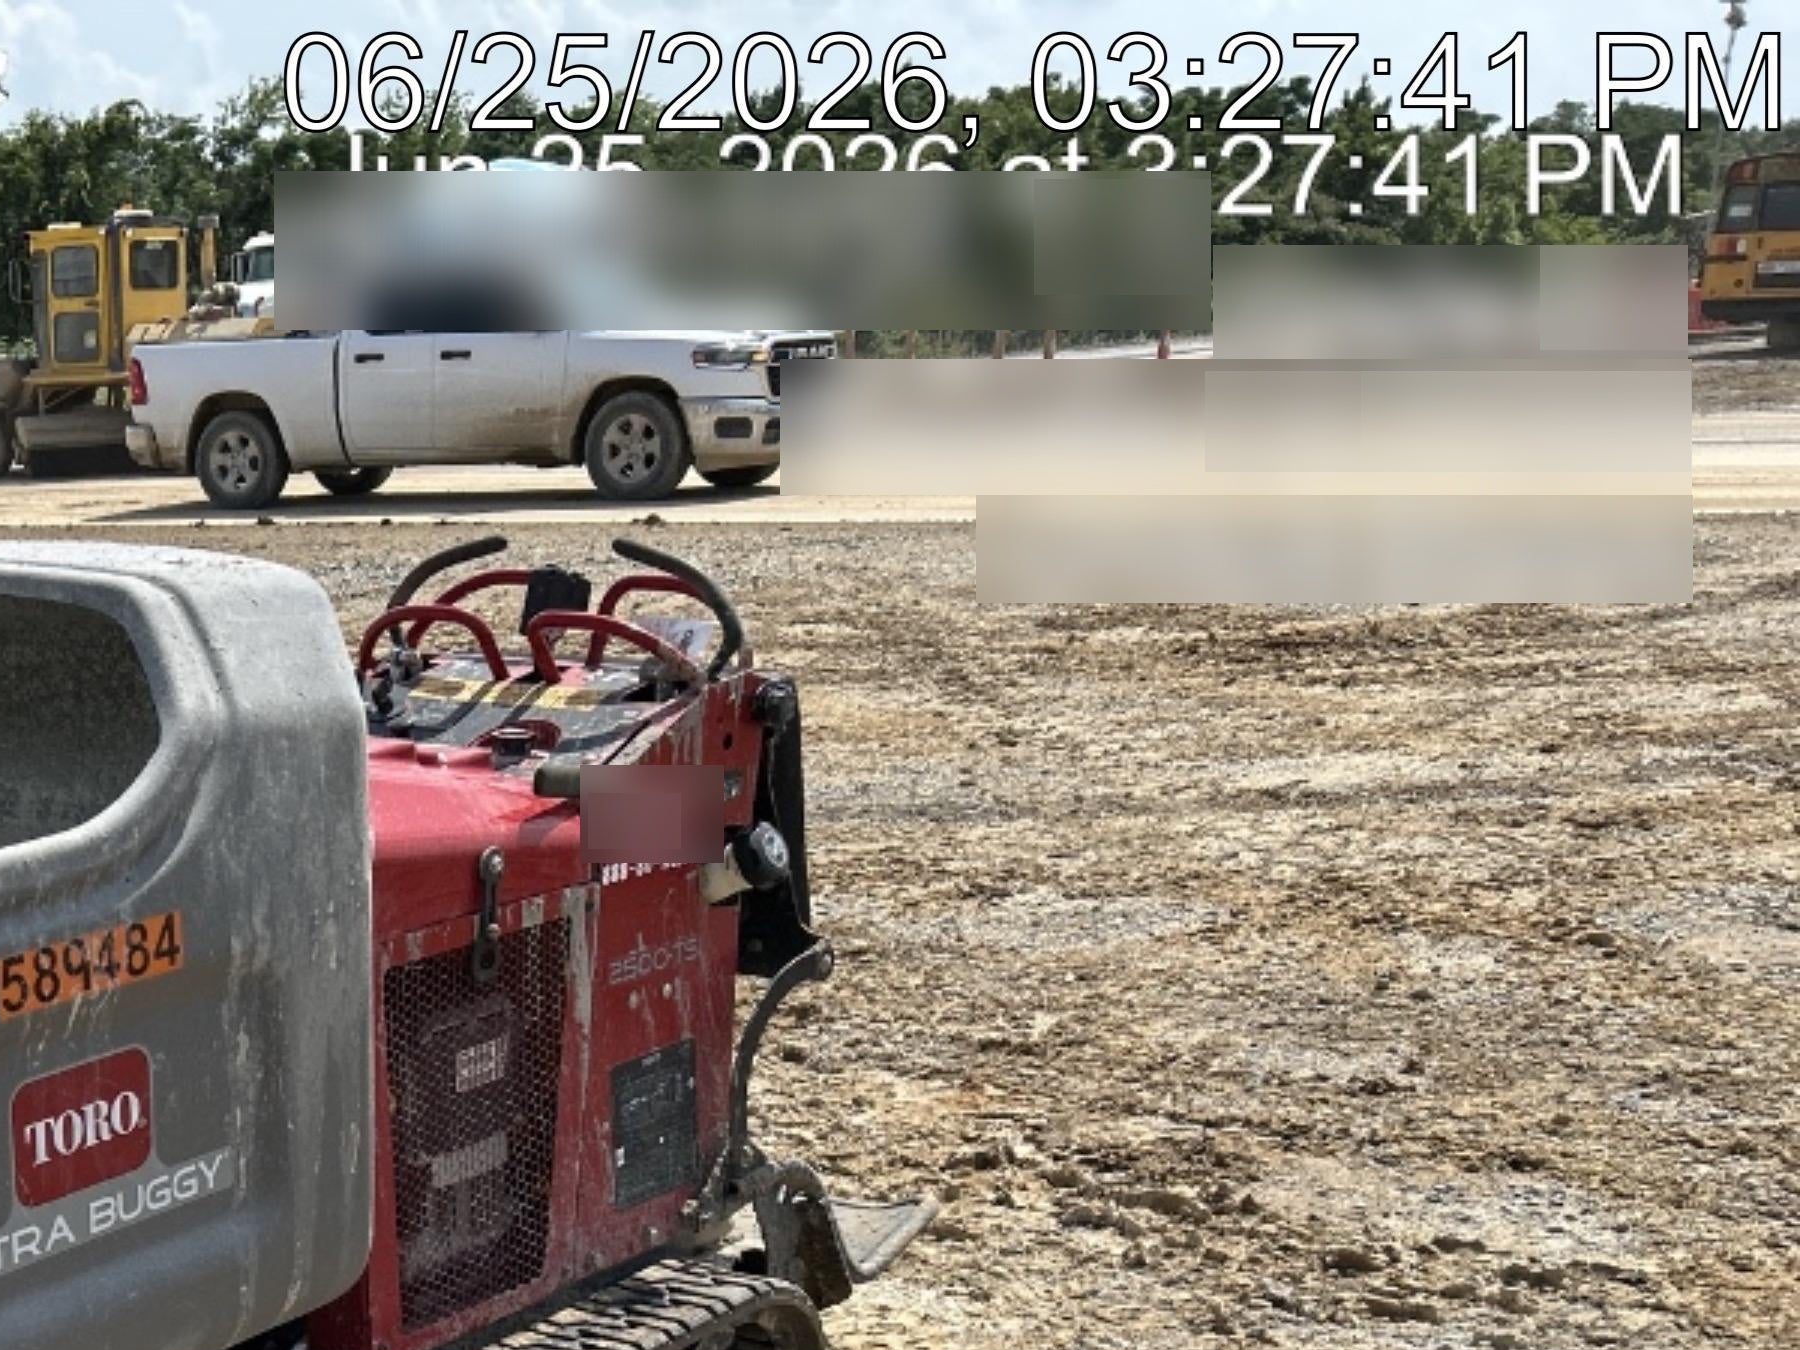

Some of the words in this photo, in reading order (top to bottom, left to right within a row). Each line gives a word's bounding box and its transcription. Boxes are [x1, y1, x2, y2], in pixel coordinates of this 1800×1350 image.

[0, 913, 181, 1013] 589484
[24, 1090, 142, 1167] TORO
[88, 1154, 224, 1235] BUGGY
